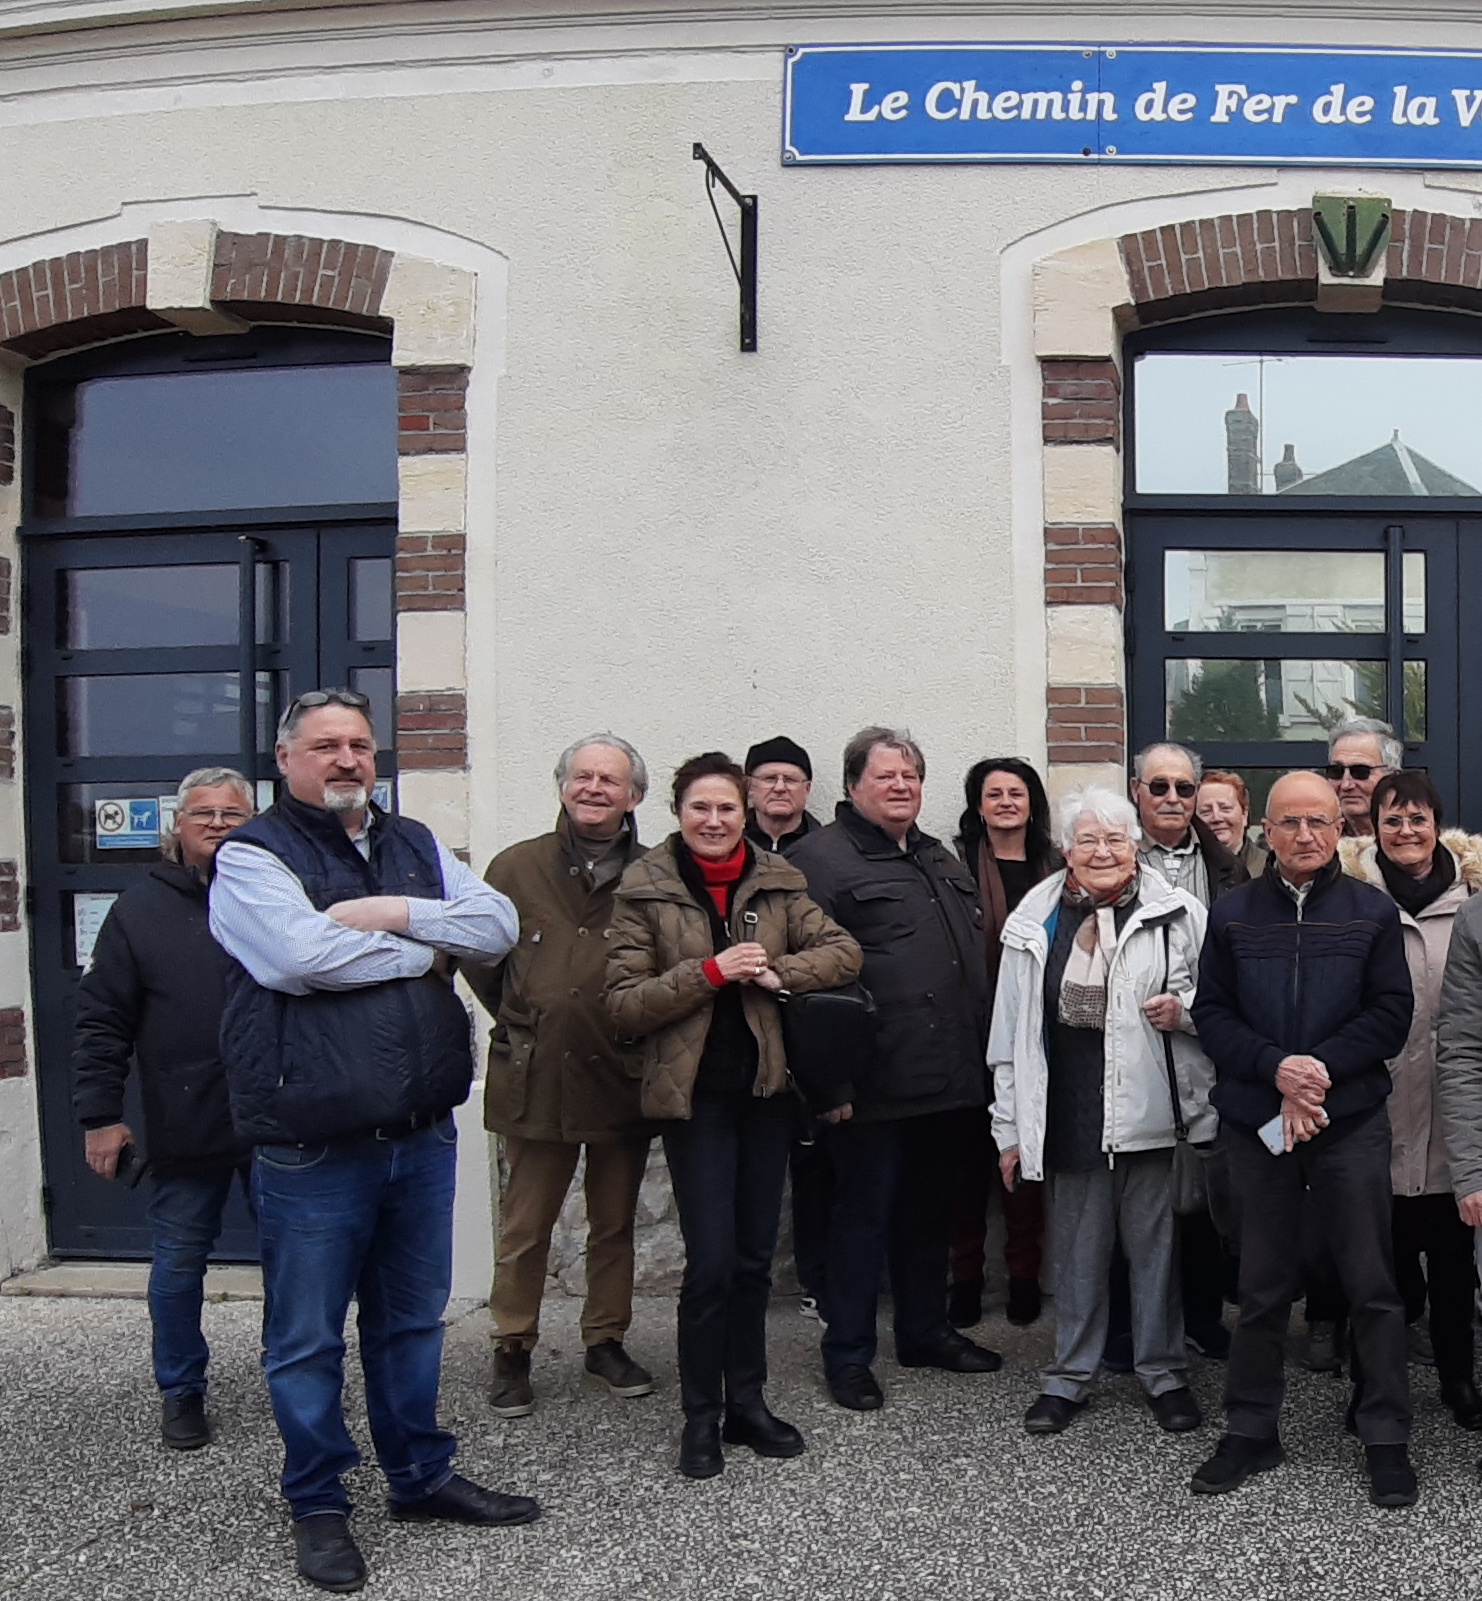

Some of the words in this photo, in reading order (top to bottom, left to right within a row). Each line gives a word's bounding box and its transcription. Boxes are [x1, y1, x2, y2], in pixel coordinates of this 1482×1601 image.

[845, 83, 908, 120] Le
[926, 80, 1118, 121] Chemin
[1135, 81, 1197, 122] de
[1211, 84, 1298, 123] Fer
[1313, 84, 1374, 124] de
[1392, 86, 1440, 126] la
